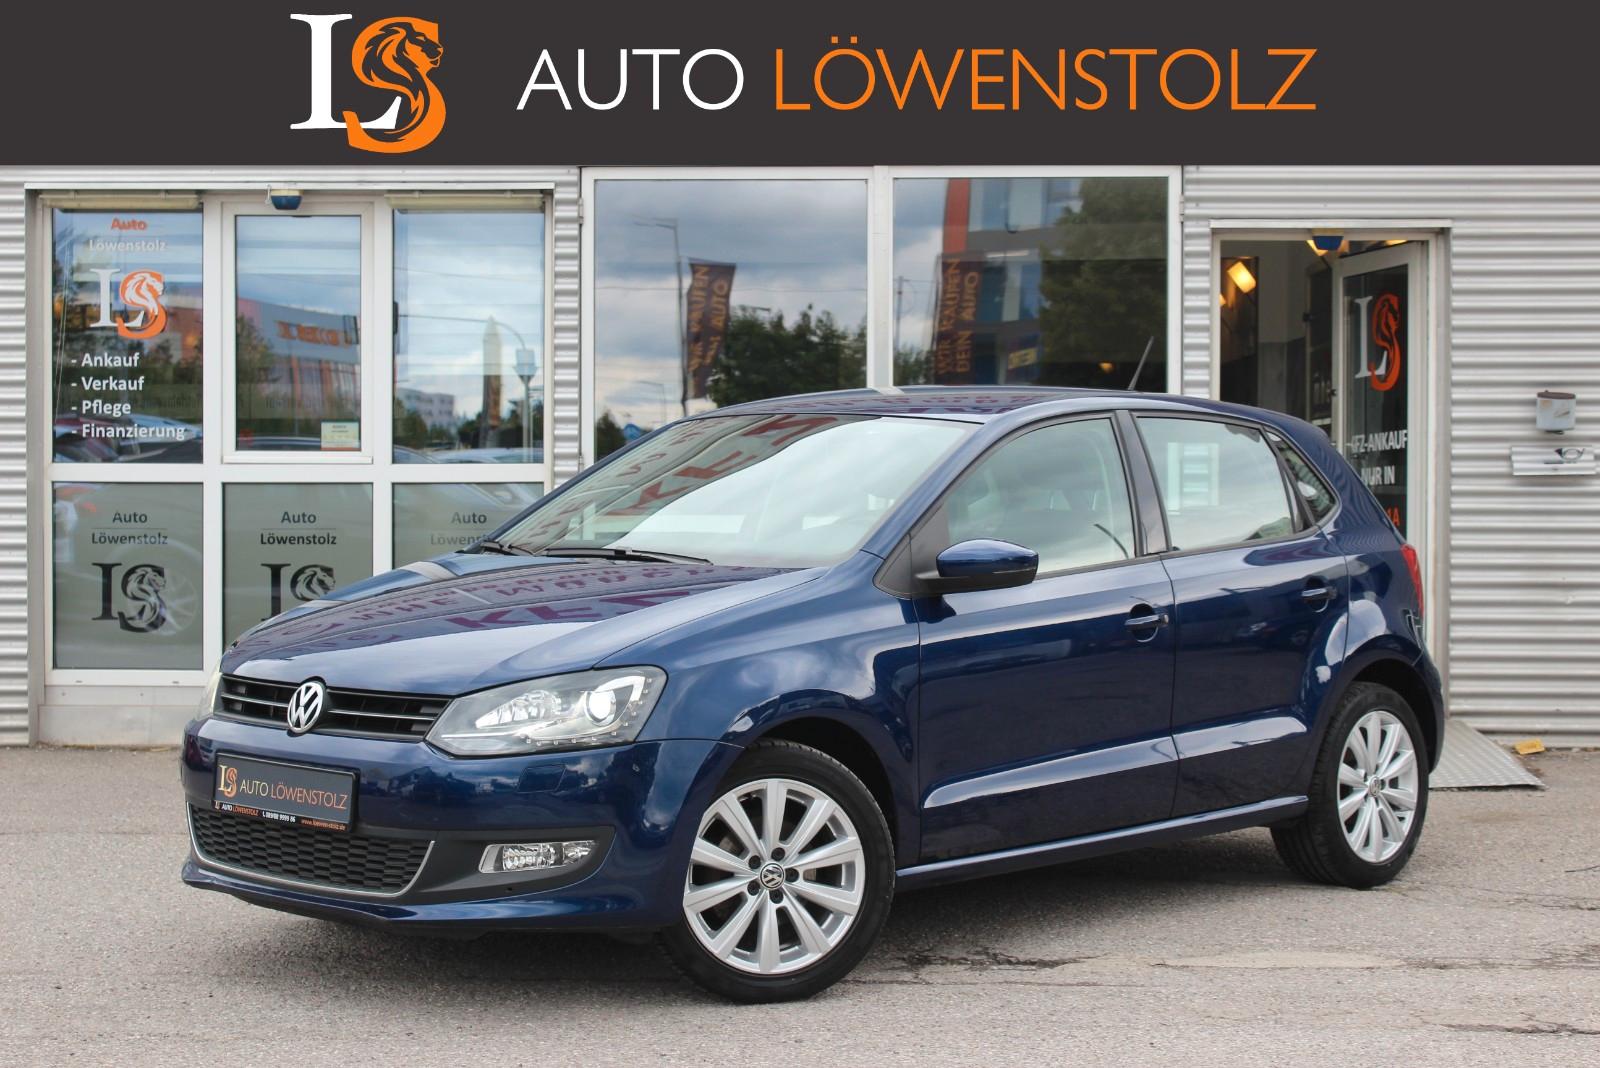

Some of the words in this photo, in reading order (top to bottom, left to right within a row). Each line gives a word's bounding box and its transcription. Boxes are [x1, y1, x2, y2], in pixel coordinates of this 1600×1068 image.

[111, 218, 147, 231] Auto
[89, 238, 166, 251] Löwenstolz
[90, 268, 167, 338] LS
[81, 352, 140, 367] Ankauf
[81, 375, 145, 390] Verkauf
[82, 399, 131, 417] Pflege
[82, 423, 185, 440] Finanzierung
[1361, 467, 1382, 485] NUR
[1384, 466, 1395, 485] IN
[112, 511, 148, 524] Auto
[280, 511, 317, 524] Auto
[451, 511, 487, 524] Auto
[91, 532, 168, 545] Löwenstolz
[260, 532, 337, 545] Löwenstolz
[287, 681, 324, 733] VW
[240, 779, 269, 797] AUTO
[270, 782, 349, 811] LÖWENSTOLZ
